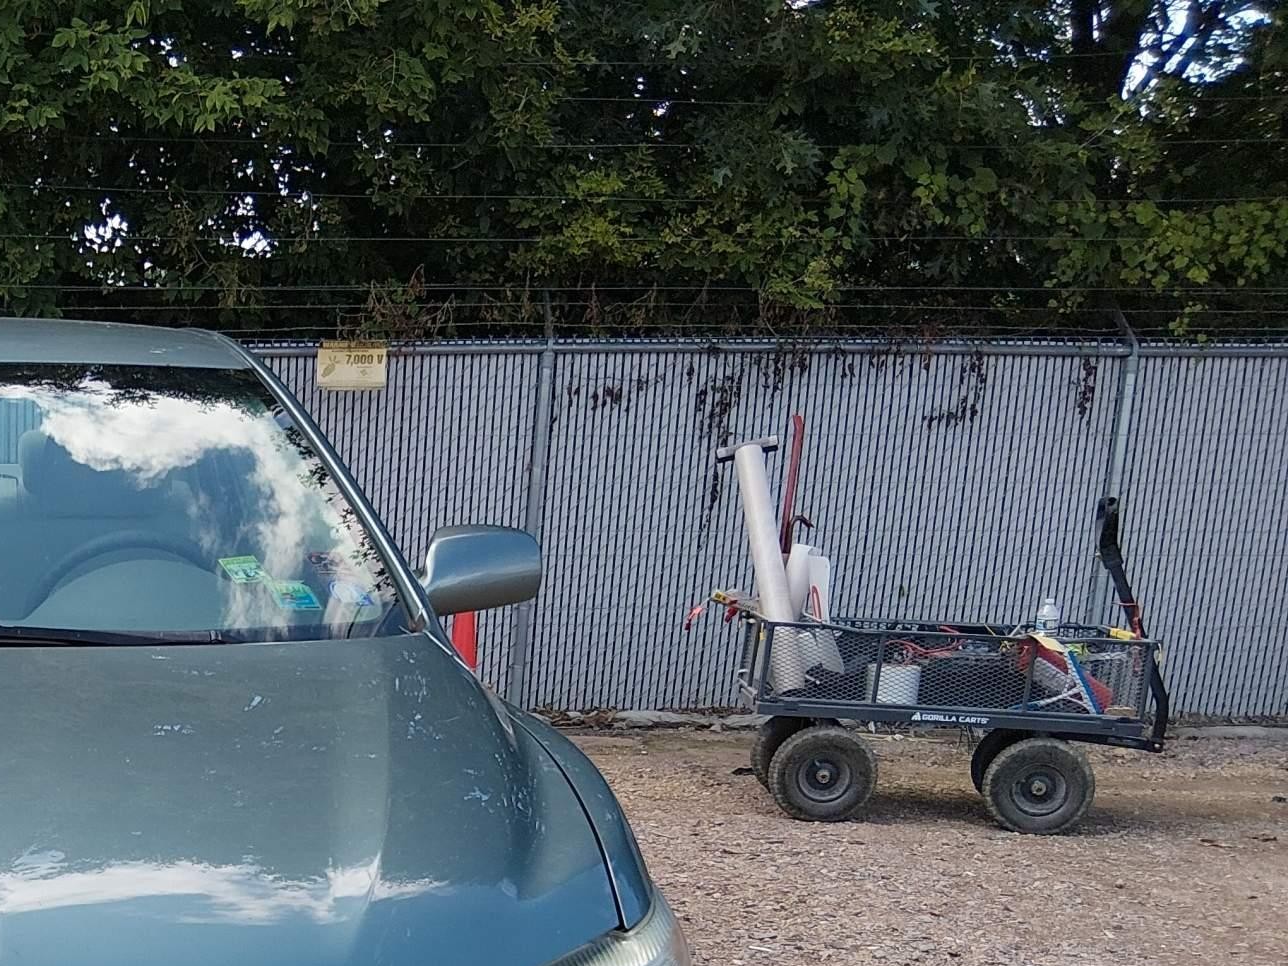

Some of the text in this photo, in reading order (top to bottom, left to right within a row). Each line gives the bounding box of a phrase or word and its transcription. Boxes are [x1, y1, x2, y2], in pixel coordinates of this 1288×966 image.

[345, 354, 384, 366] 7,000 V
[921, 713, 988, 724] GORILLA CARTS
